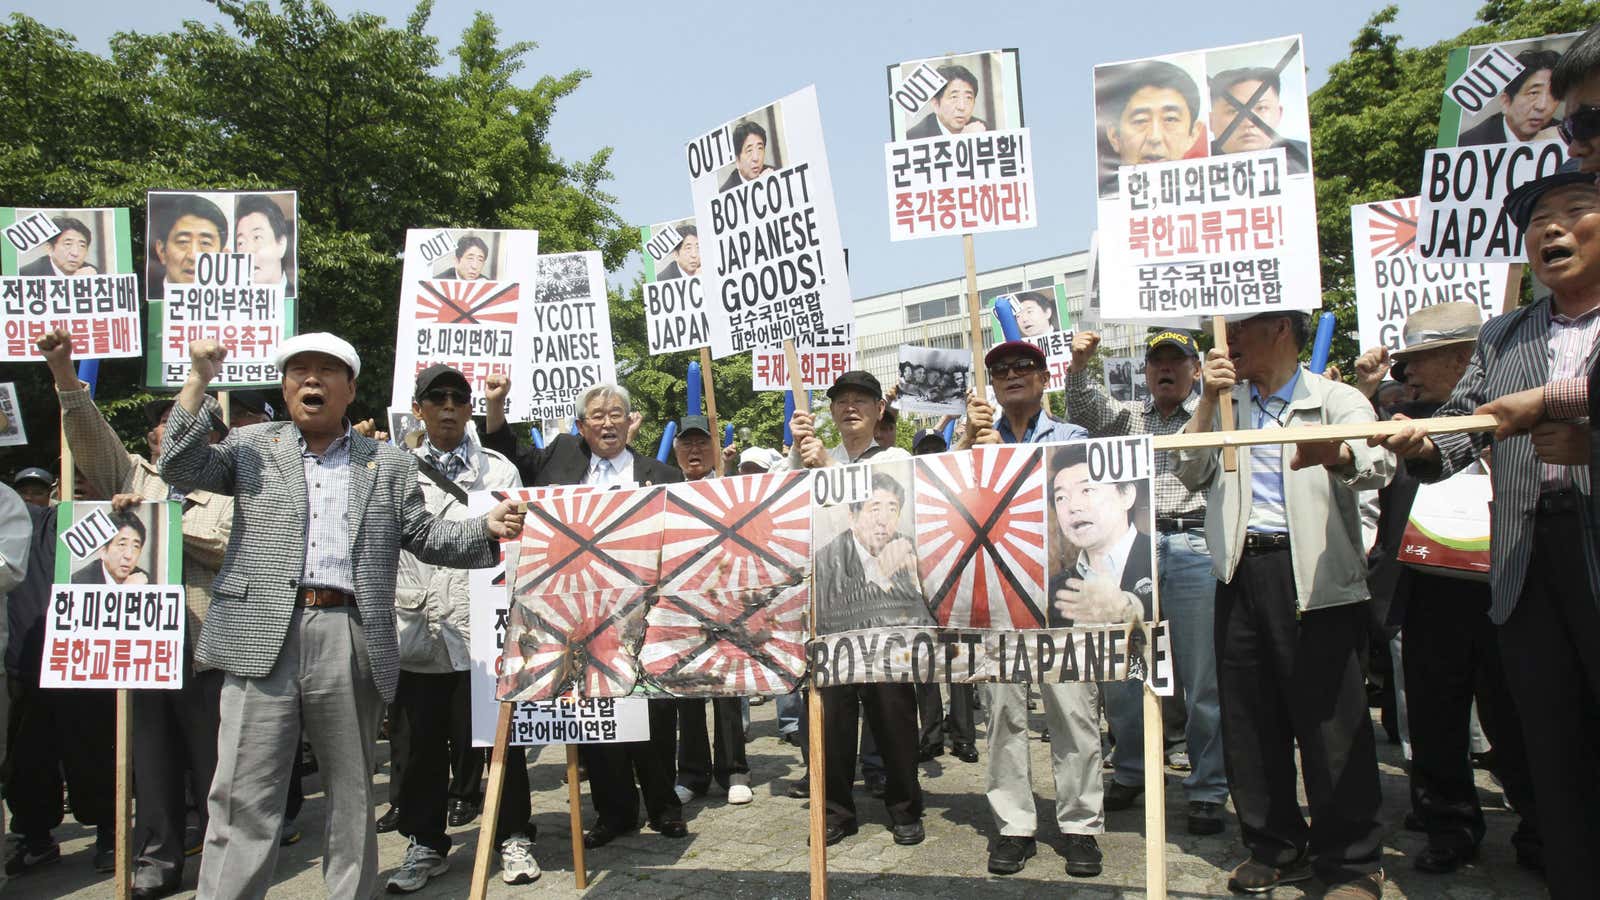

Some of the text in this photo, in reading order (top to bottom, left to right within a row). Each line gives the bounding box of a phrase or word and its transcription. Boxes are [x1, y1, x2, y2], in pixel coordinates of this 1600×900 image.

[895, 63, 945, 113] OUT!
[1451, 48, 1524, 112] OUT!
[688, 125, 734, 179] OUT!
[892, 134, 1025, 188] 군국주의부활!
[1128, 157, 1282, 211] 한,미외면하고
[1429, 143, 1563, 202] BOYCO
[711, 163, 811, 236] BOYCOTT
[895, 182, 1030, 234] 즉각중단하라!
[6, 212, 57, 252] OUT!
[419, 231, 457, 262] OUT!
[647, 225, 681, 261] OUT!
[718, 207, 820, 277] JAPANESE
[1128, 206, 1285, 259] 북한교류규탄!
[1420, 207, 1525, 258] JAPA
[198, 252, 251, 286] OUT!
[721, 250, 826, 313] GOODS!
[1139, 258, 1281, 291] 보수국민연합
[2, 276, 137, 315] 전쟁전범참배
[169, 289, 276, 321] 군위안부착취!
[648, 277, 703, 316] BOYC
[729, 291, 820, 333] 보수국민연합
[1138, 281, 1283, 312] 대한어버이연합
[5, 318, 139, 357] 일본품불매!
[534, 302, 596, 333] YCOTT
[651, 312, 711, 350] JAPAN
[731, 310, 824, 351] 대한어버이연합
[417, 329, 513, 357] 한,미외면하고
[531, 332, 600, 364] PANESE
[166, 364, 280, 383] 보민연합
[532, 364, 602, 394] OODS!
[757, 352, 851, 386] 국제회규탄!
[1087, 437, 1153, 482] OUT!
[813, 463, 871, 506] OUT!
[65, 509, 117, 558] OUT!
[55, 591, 179, 631] 한,미외면하고
[50, 637, 178, 682] 북한교류규탄!
[811, 625, 1169, 689] BOYCOTT JAPANEE
[512, 697, 616, 719] 수국민연합
